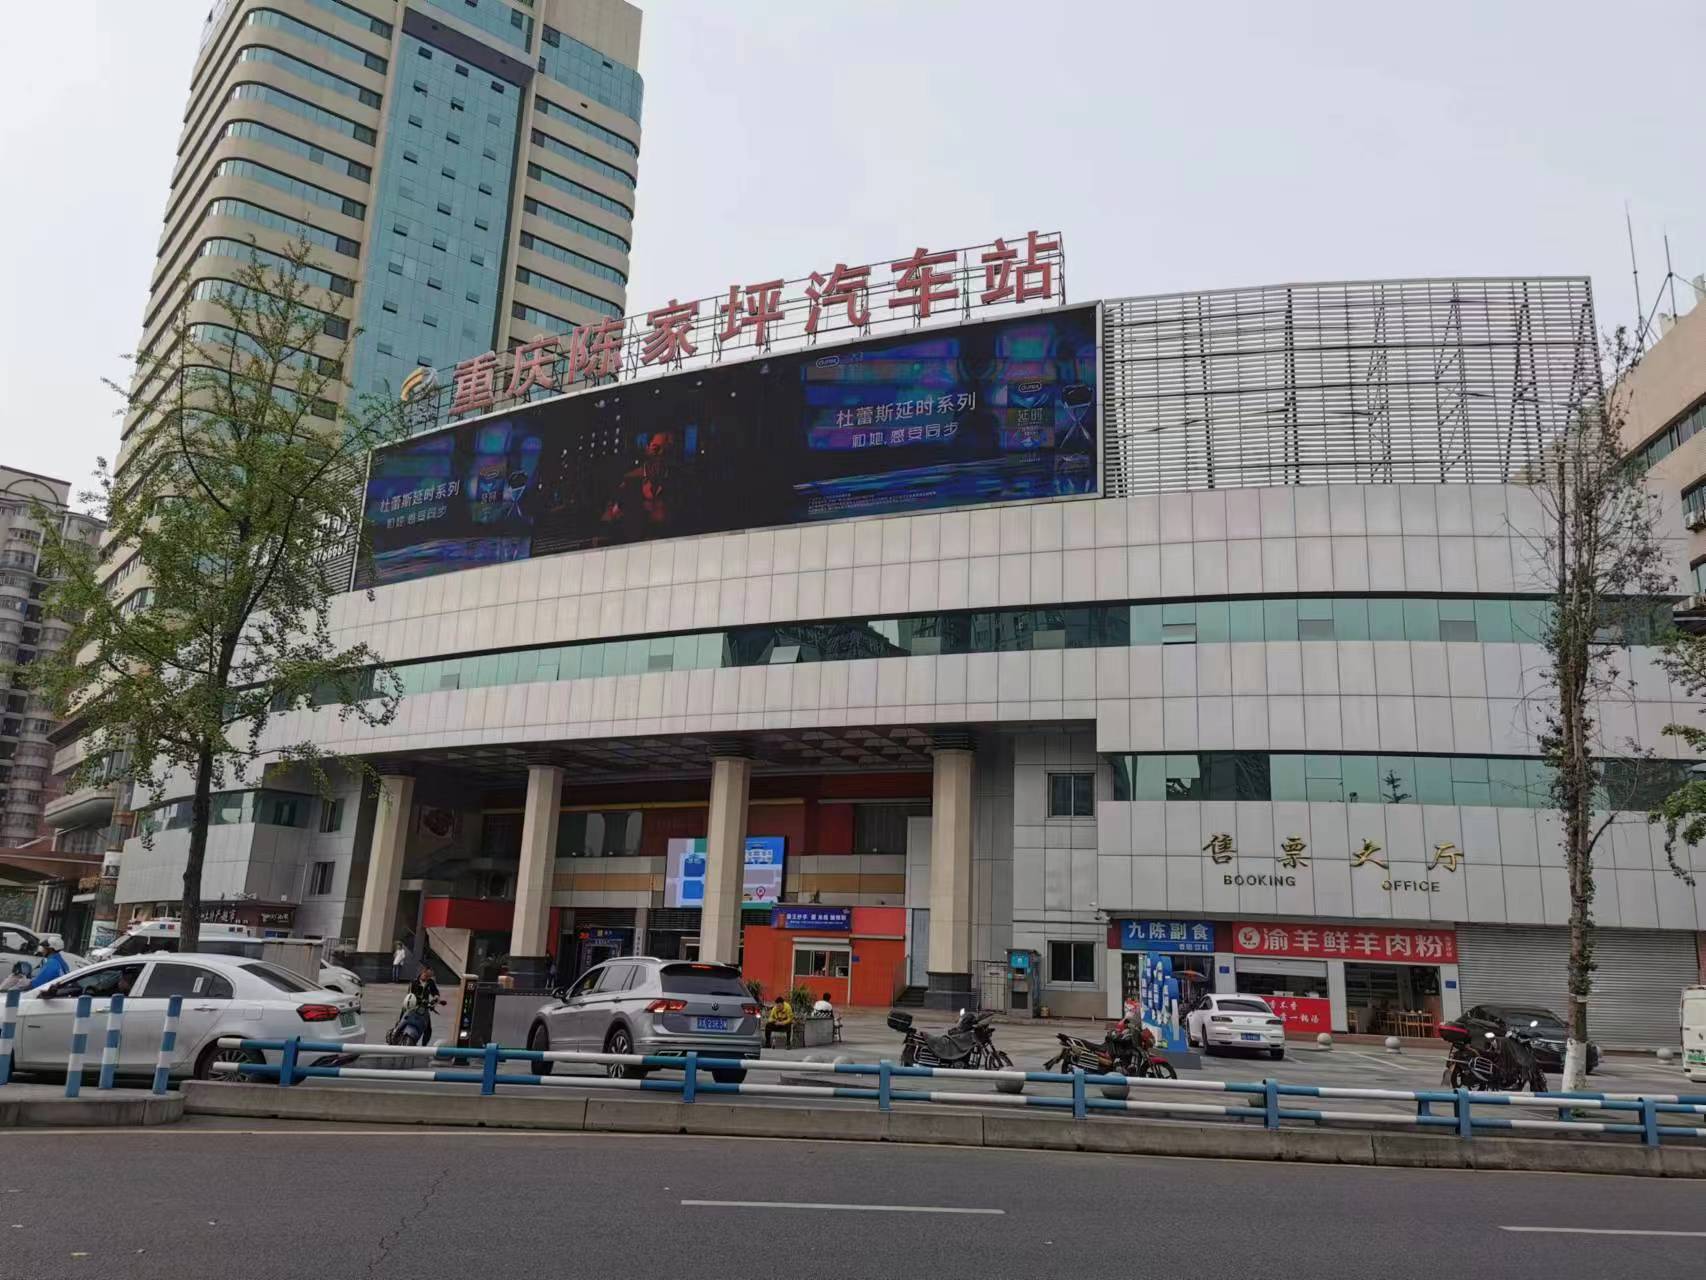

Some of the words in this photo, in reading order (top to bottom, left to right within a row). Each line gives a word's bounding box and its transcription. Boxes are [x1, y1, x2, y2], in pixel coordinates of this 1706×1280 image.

[450, 231, 1058, 415] 重庆陈家坪汽车站
[836, 392, 976, 428] 杜蕾斯延时系列
[1203, 834, 1464, 872] 售票大厅
[1223, 875, 1296, 886] BOOKING
[1382, 880, 1440, 892] OFFICE
[1128, 922, 1208, 940] 九陈副食
[1263, 928, 1443, 957] 渝羊鲜羊肉粉
